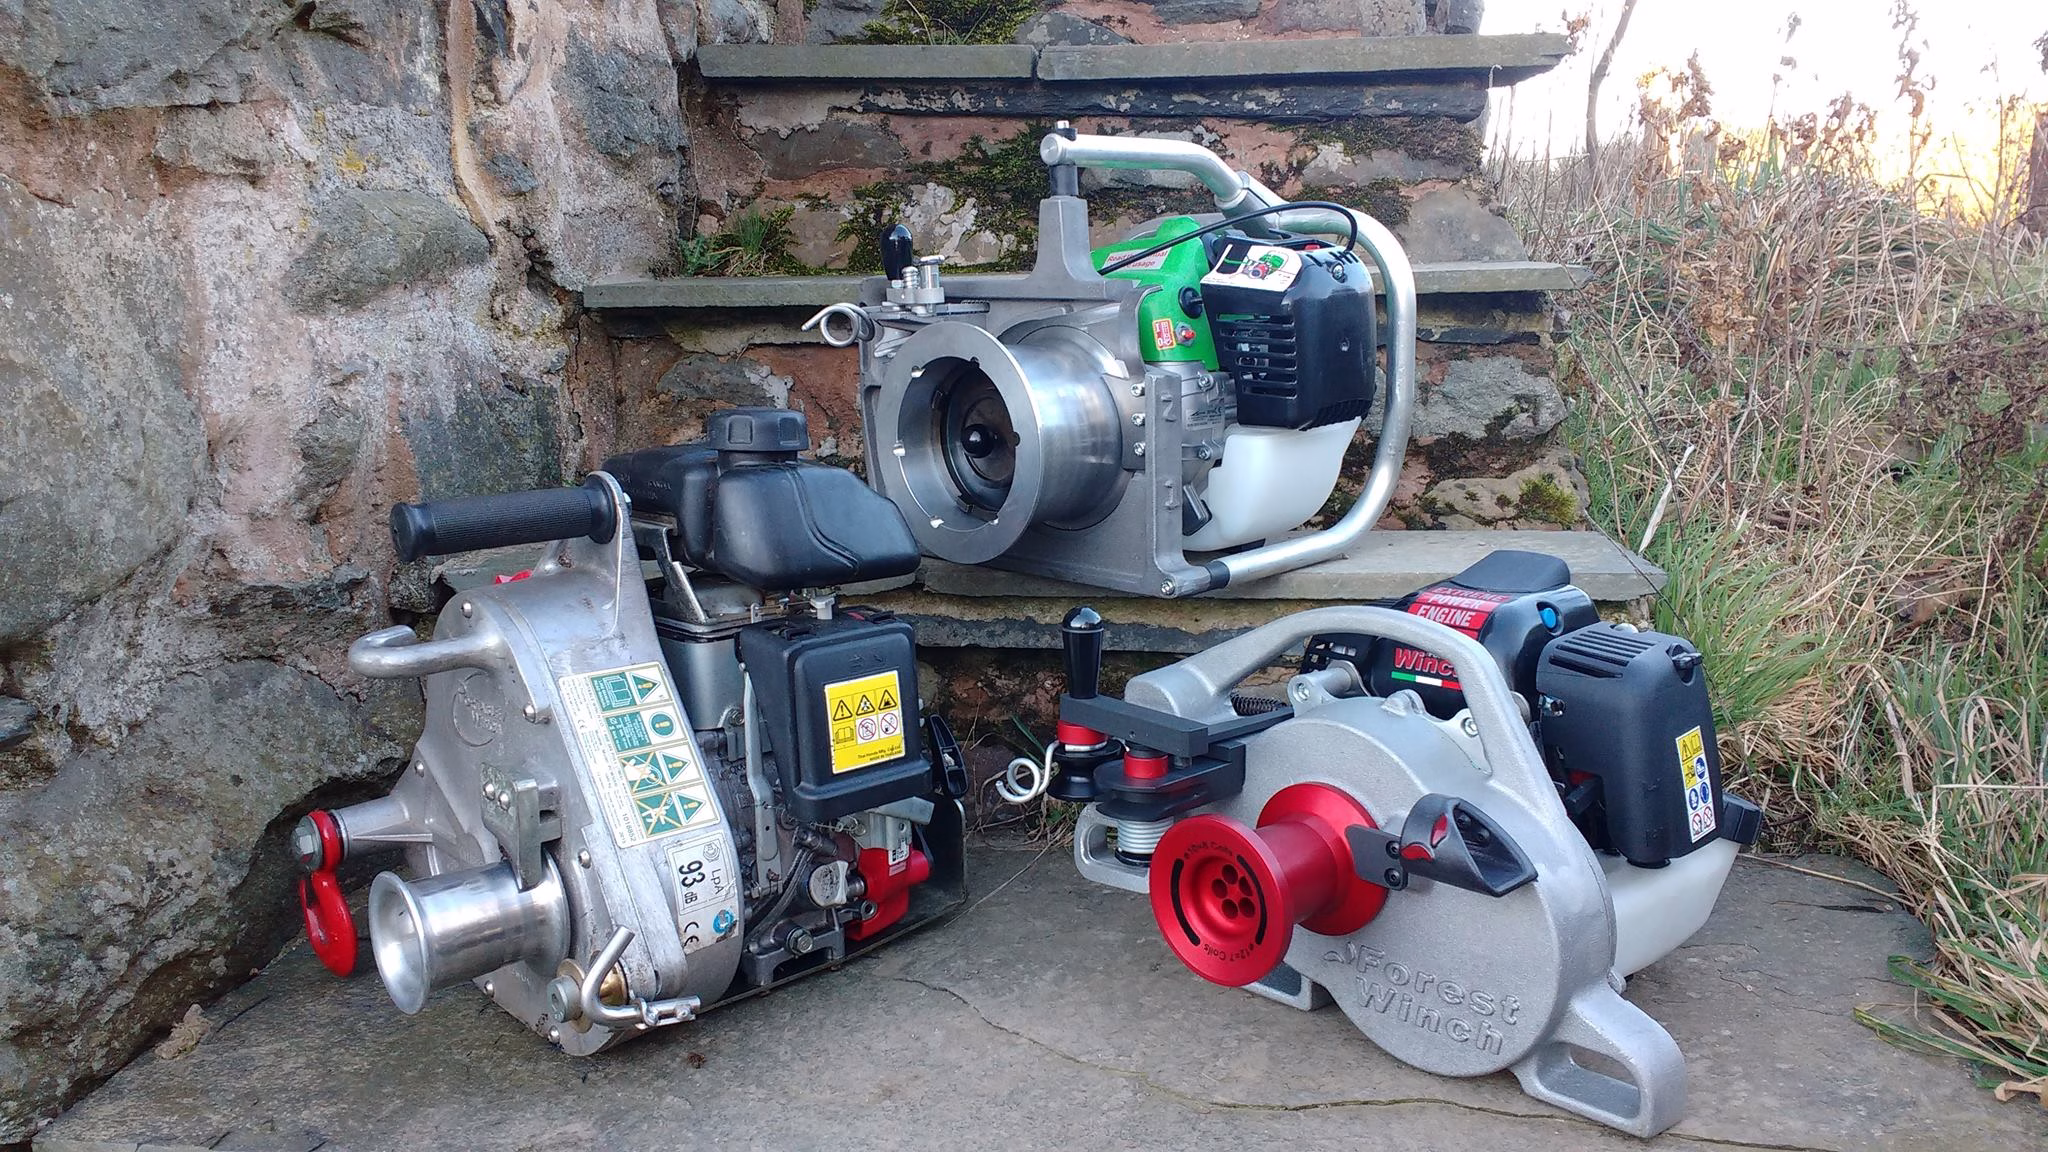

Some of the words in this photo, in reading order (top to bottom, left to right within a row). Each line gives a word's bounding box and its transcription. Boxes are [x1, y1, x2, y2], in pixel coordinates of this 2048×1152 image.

[1428, 594, 1484, 609] POWER
[1431, 587, 1512, 602] EXTREME
[1416, 605, 1476, 627] ENGINE
[1394, 647, 1459, 677] Winc
[678, 860, 706, 889] 93
[711, 868, 725, 895] LpA
[684, 890, 698, 904] dB
[1204, 943, 1227, 961] Coils
[1356, 944, 1521, 1025] Forest
[1356, 975, 1503, 1055] Winch
